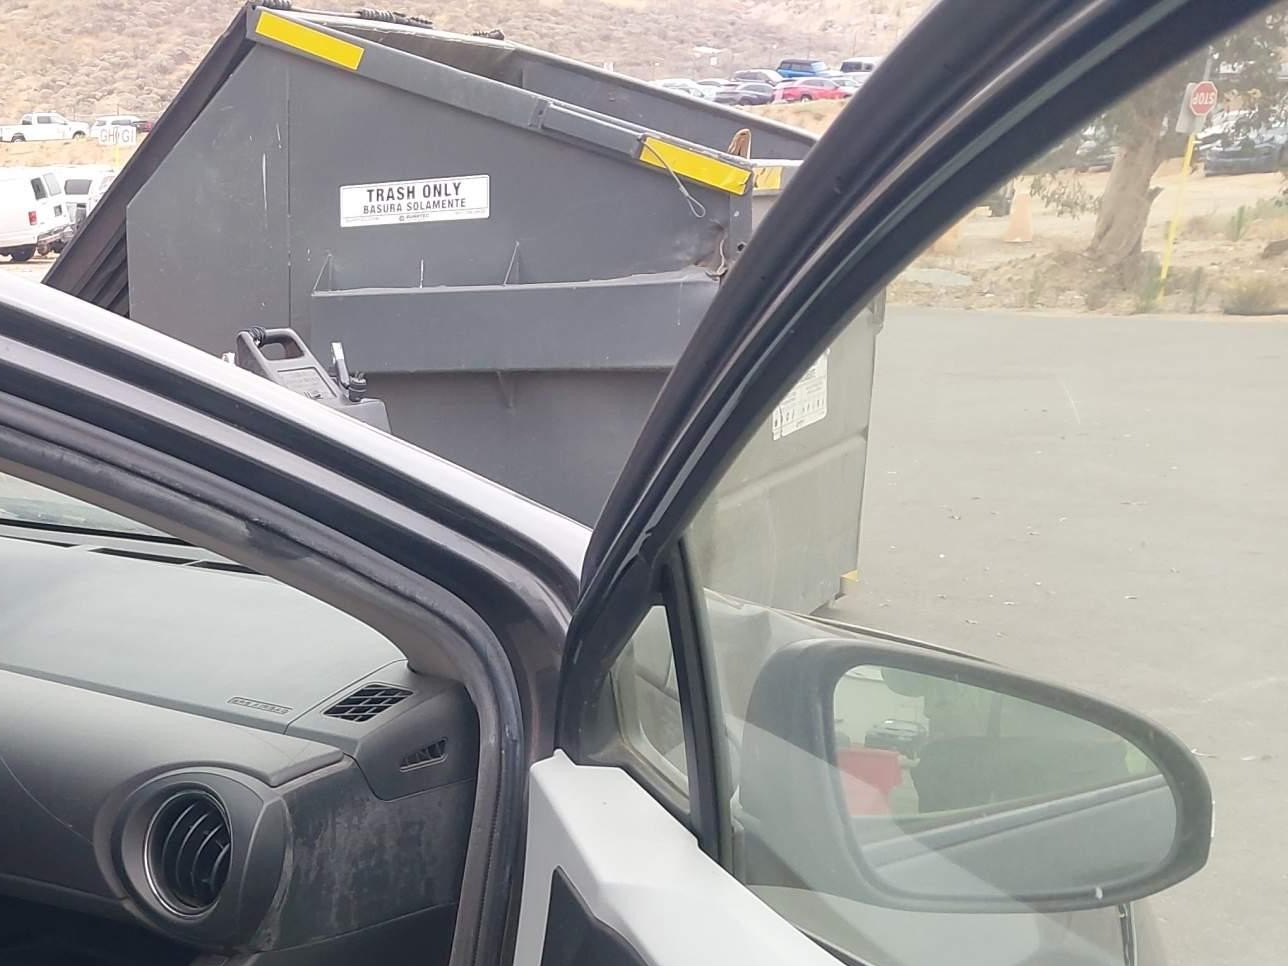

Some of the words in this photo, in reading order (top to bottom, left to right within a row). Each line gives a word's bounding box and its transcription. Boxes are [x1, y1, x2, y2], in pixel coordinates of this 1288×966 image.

[1192, 92, 1216, 104] STOP
[366, 186, 416, 202] TRASH
[422, 182, 462, 198] ONLY
[363, 202, 403, 214] BASURA
[406, 198, 466, 211] SOLAMENTE
